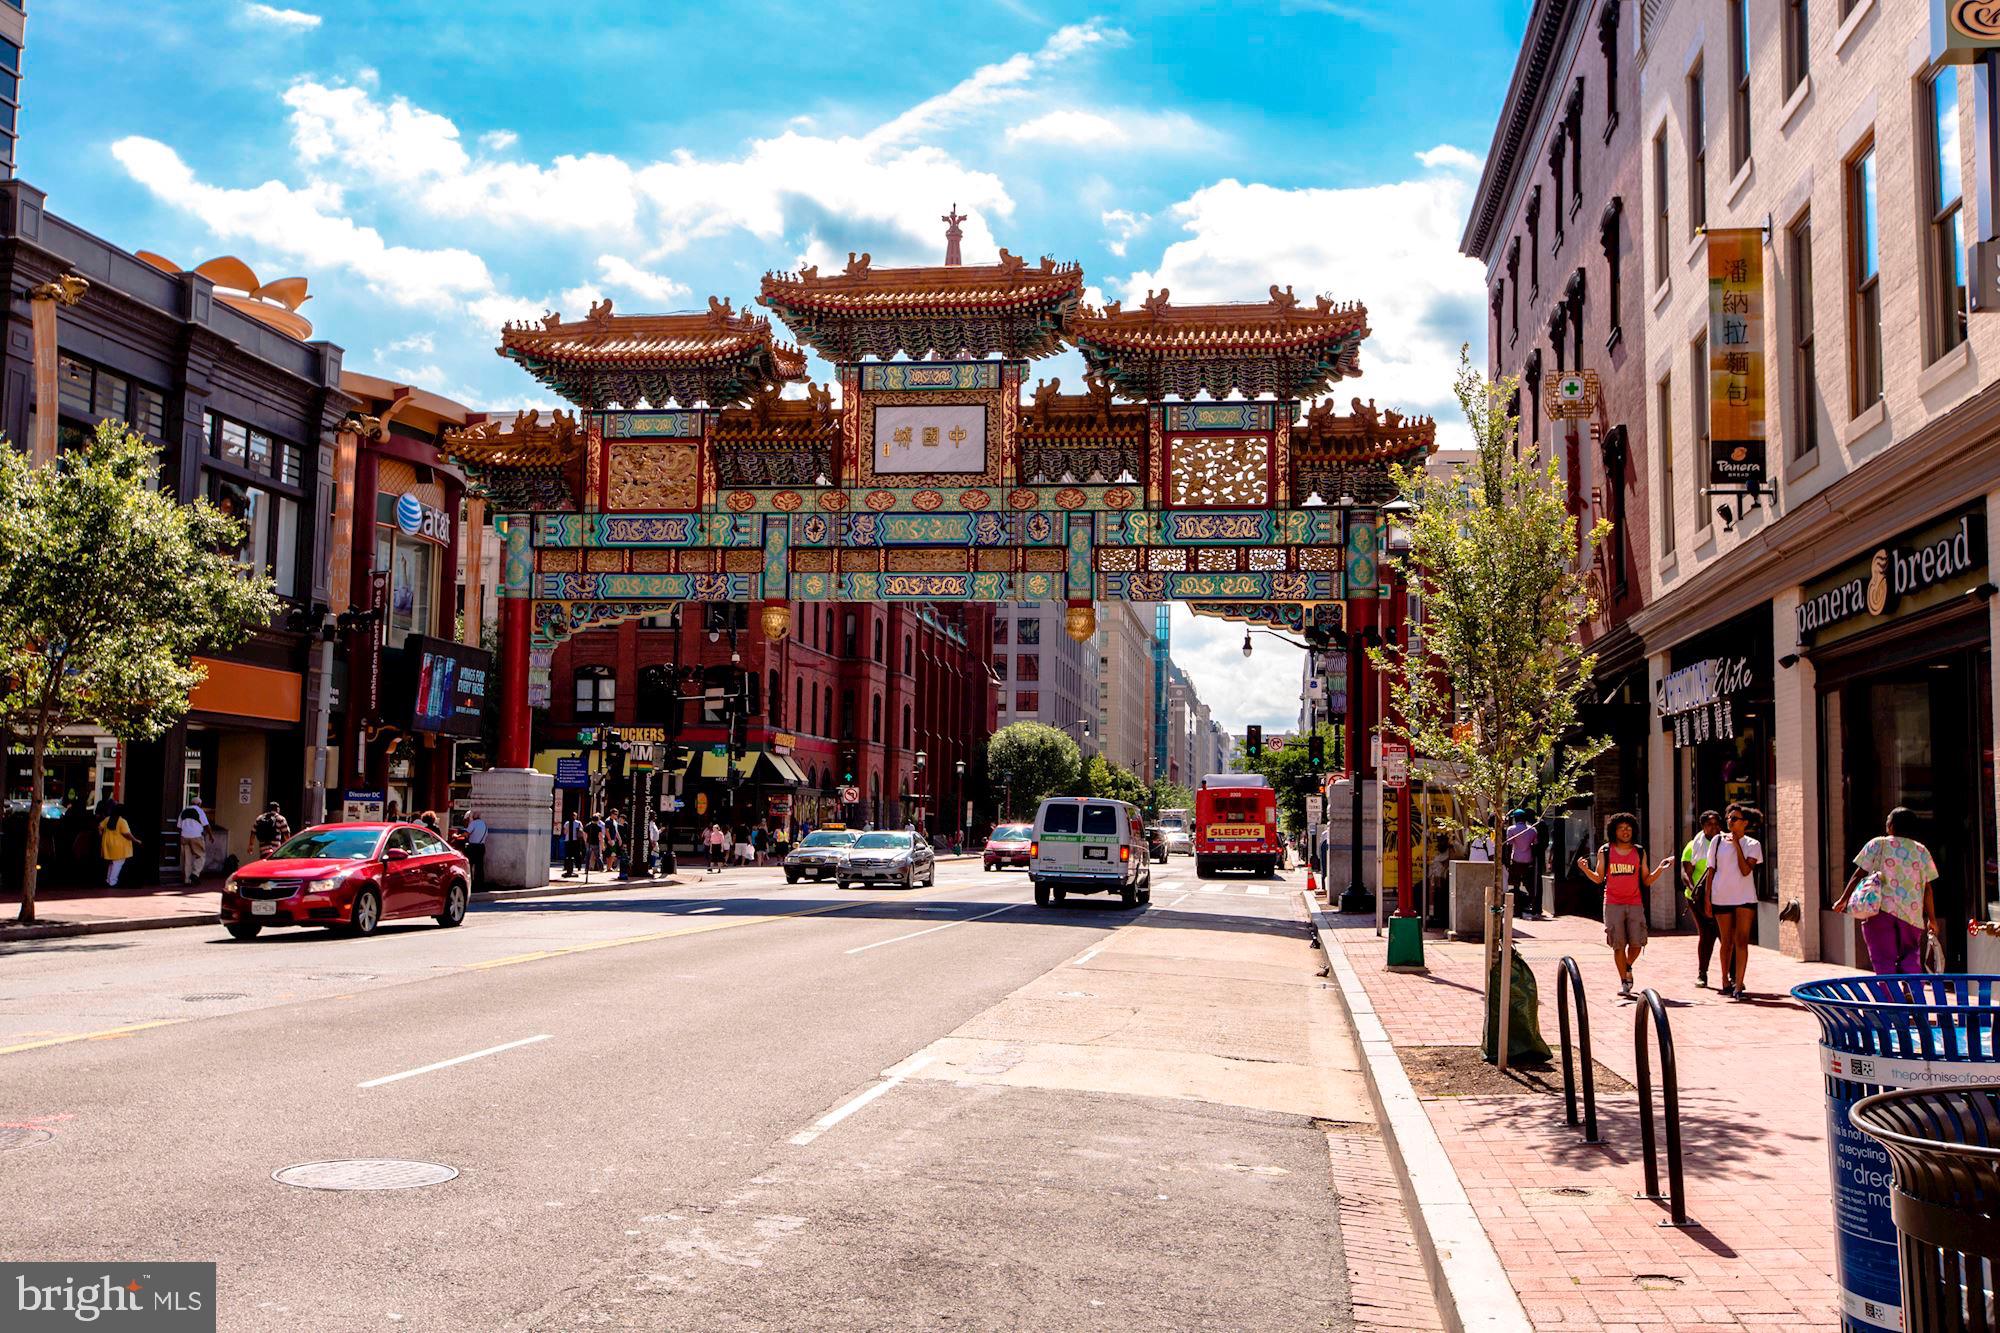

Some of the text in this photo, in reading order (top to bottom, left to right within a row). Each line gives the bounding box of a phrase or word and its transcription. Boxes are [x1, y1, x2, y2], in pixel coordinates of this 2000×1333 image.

[1723, 258, 1749, 408] 潘納拉麵包
[1716, 460, 1761, 471] Panera
[423, 508, 450, 543] at&t
[1795, 516, 1971, 646] panera bread
[1713, 656, 1752, 697] Elite
[1610, 864, 1634, 874] ALOHA!
[1848, 1128, 1861, 1140] not
[1845, 1145, 1887, 1163] recycling
